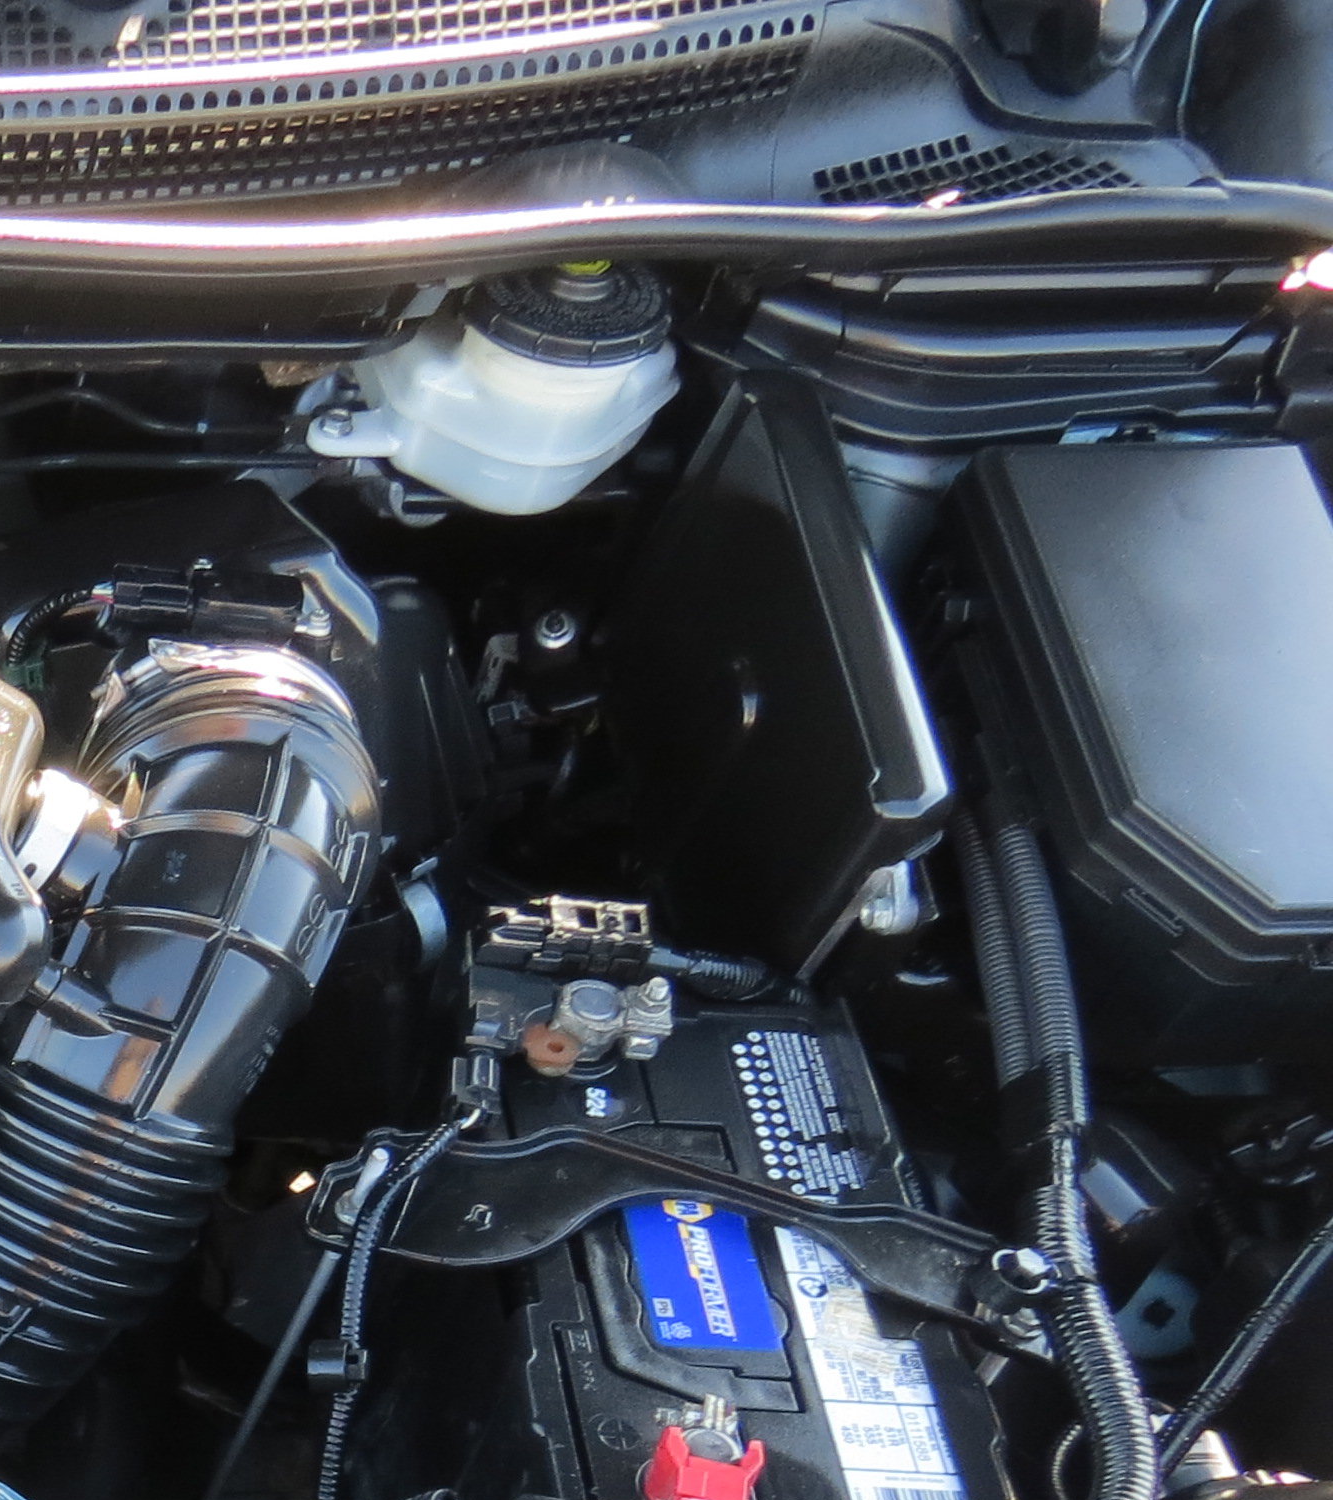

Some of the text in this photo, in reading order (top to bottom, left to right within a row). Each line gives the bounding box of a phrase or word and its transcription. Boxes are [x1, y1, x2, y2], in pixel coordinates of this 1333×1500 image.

[585, 1088, 606, 1117] 524
[687, 1225, 736, 1336] PROFORMER
[656, 1301, 671, 1314] Pb
